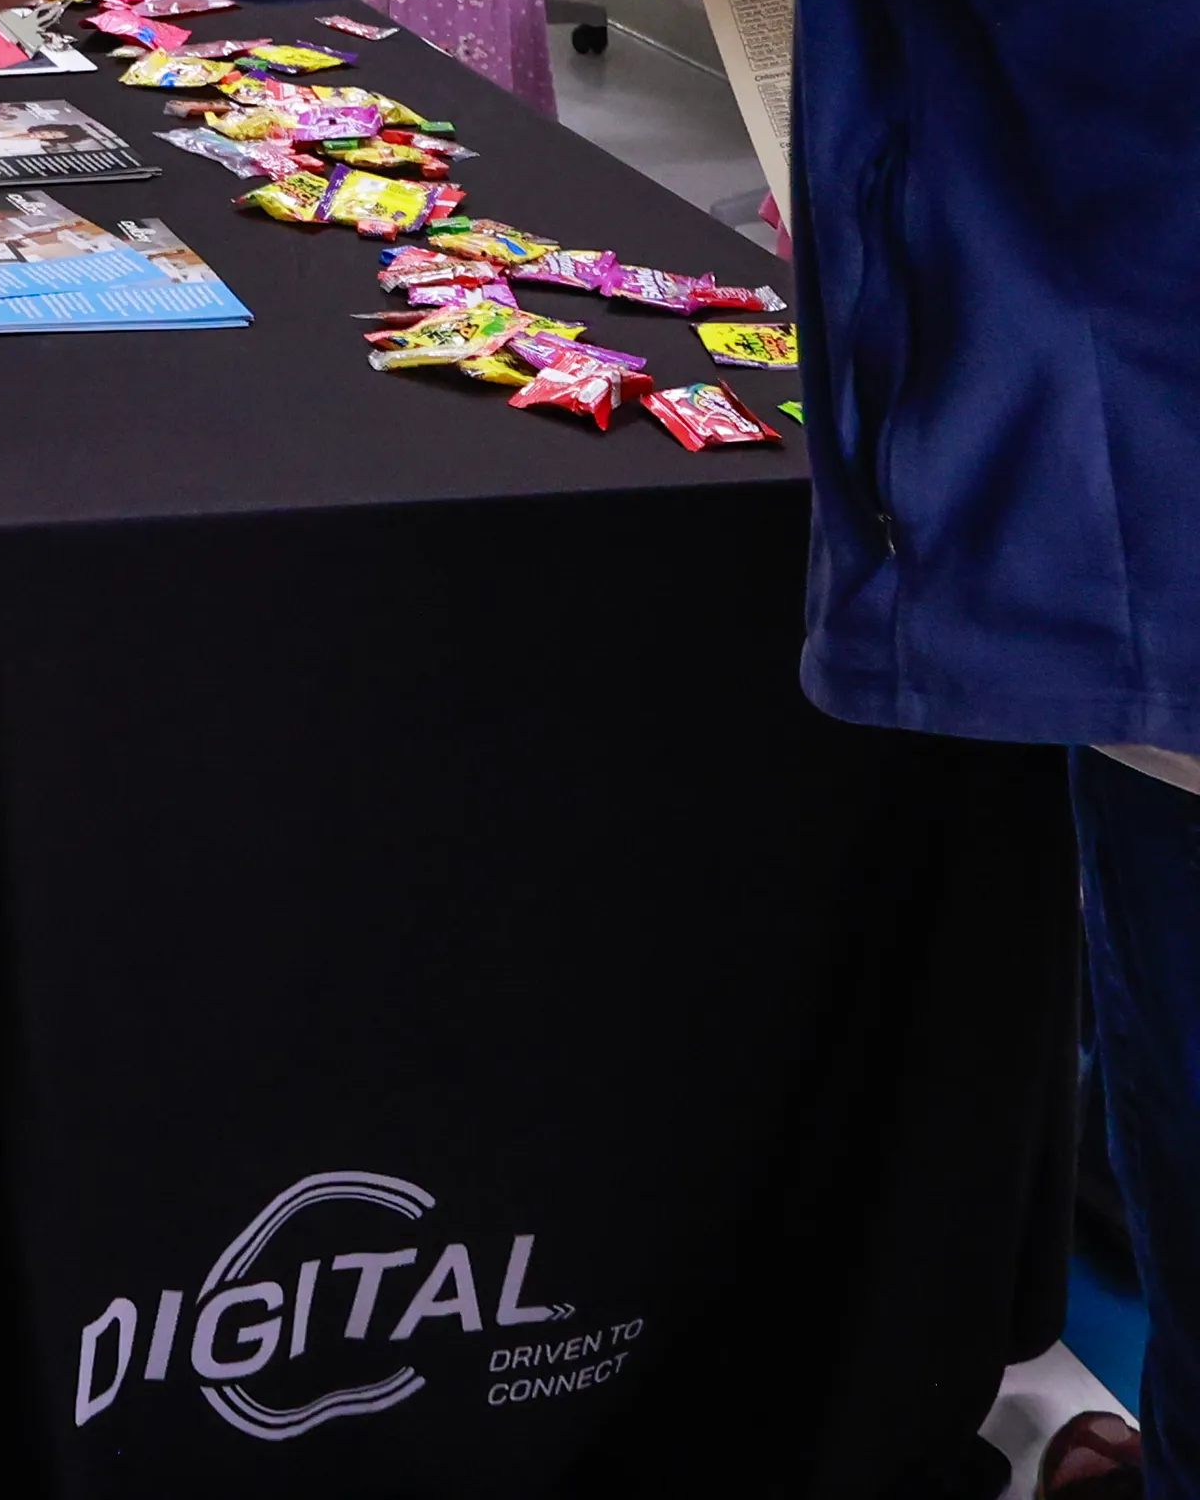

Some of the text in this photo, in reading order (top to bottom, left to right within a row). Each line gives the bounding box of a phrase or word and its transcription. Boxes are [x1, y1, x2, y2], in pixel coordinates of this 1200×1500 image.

[75, 1234, 550, 1427] DIGITAL
[489, 1318, 644, 1373] DRIVEN TO
[488, 1352, 630, 1406] CONNECT
